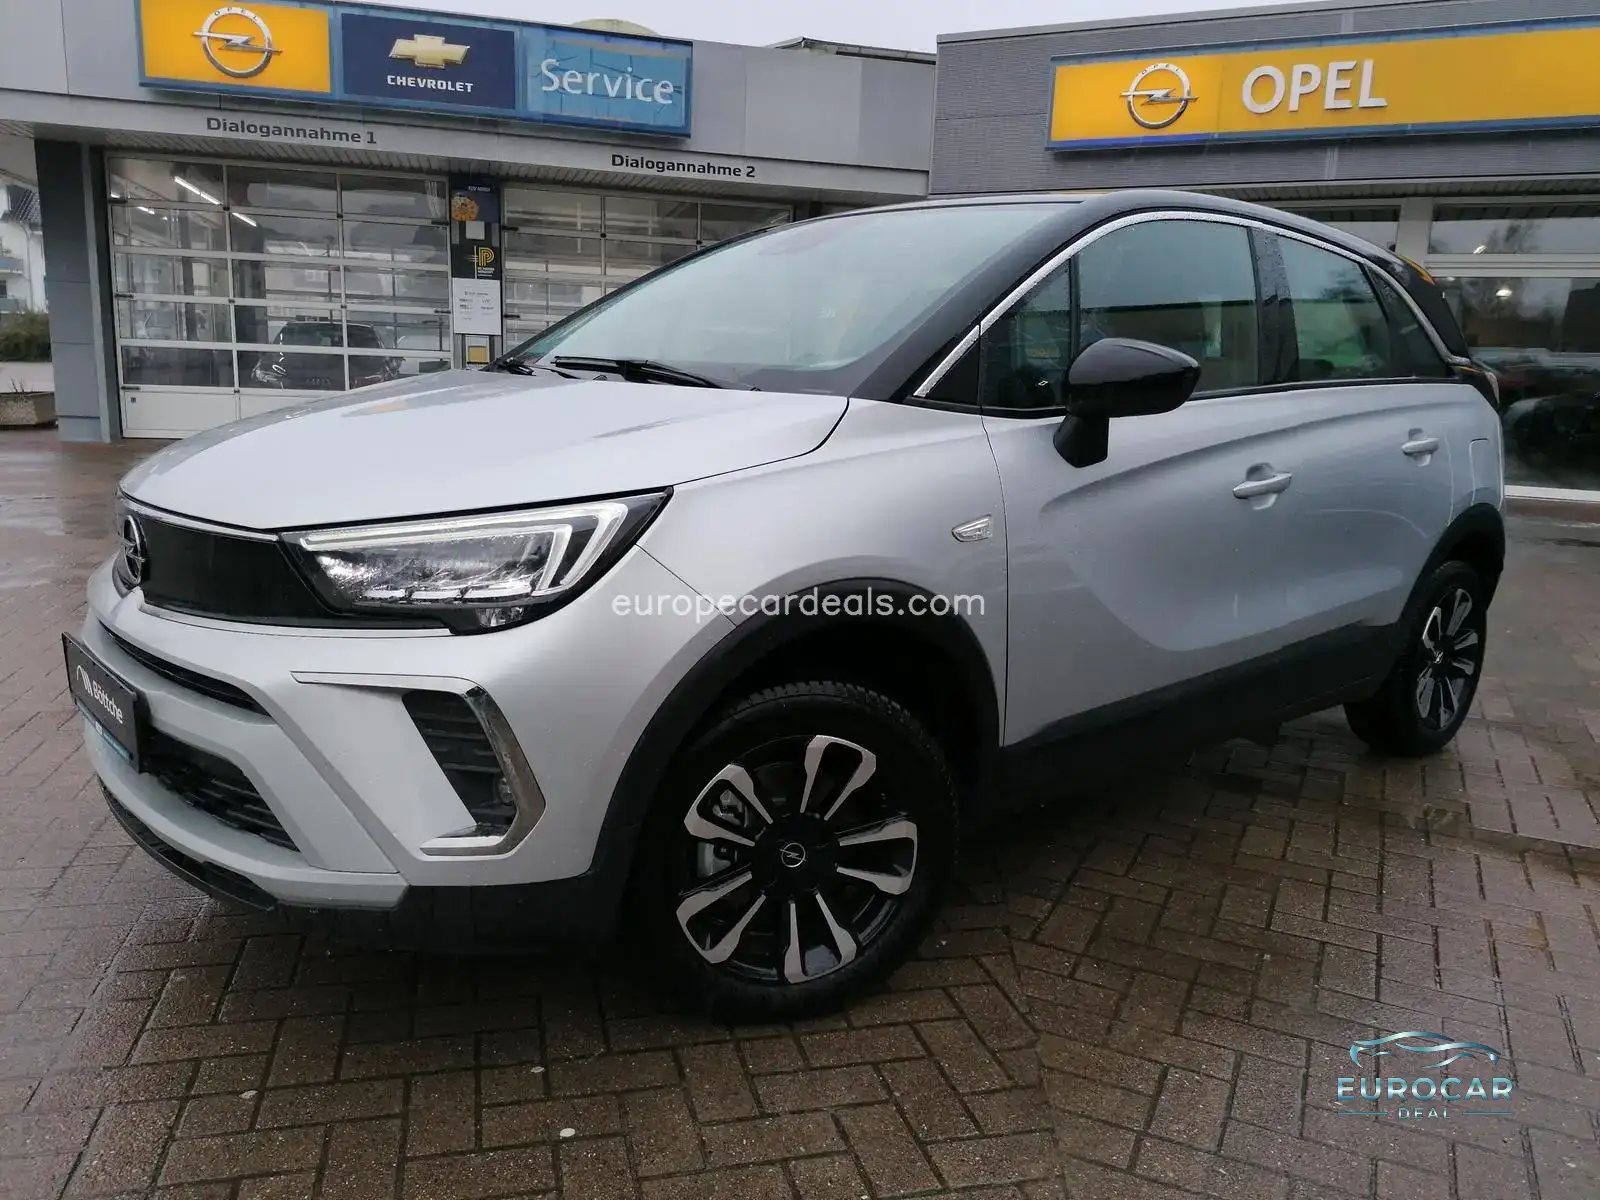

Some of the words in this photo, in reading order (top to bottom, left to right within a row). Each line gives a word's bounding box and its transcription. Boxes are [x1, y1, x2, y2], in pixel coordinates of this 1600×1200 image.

[214, 7, 258, 22] OPEL
[387, 75, 474, 93] CHEVROLET
[540, 58, 674, 105] Service
[1242, 59, 1388, 114] OPEL
[206, 117, 361, 143] Dialogannahme
[366, 131, 377, 145] 1
[611, 153, 742, 177] Dialogannahme
[746, 165, 756, 178] 2
